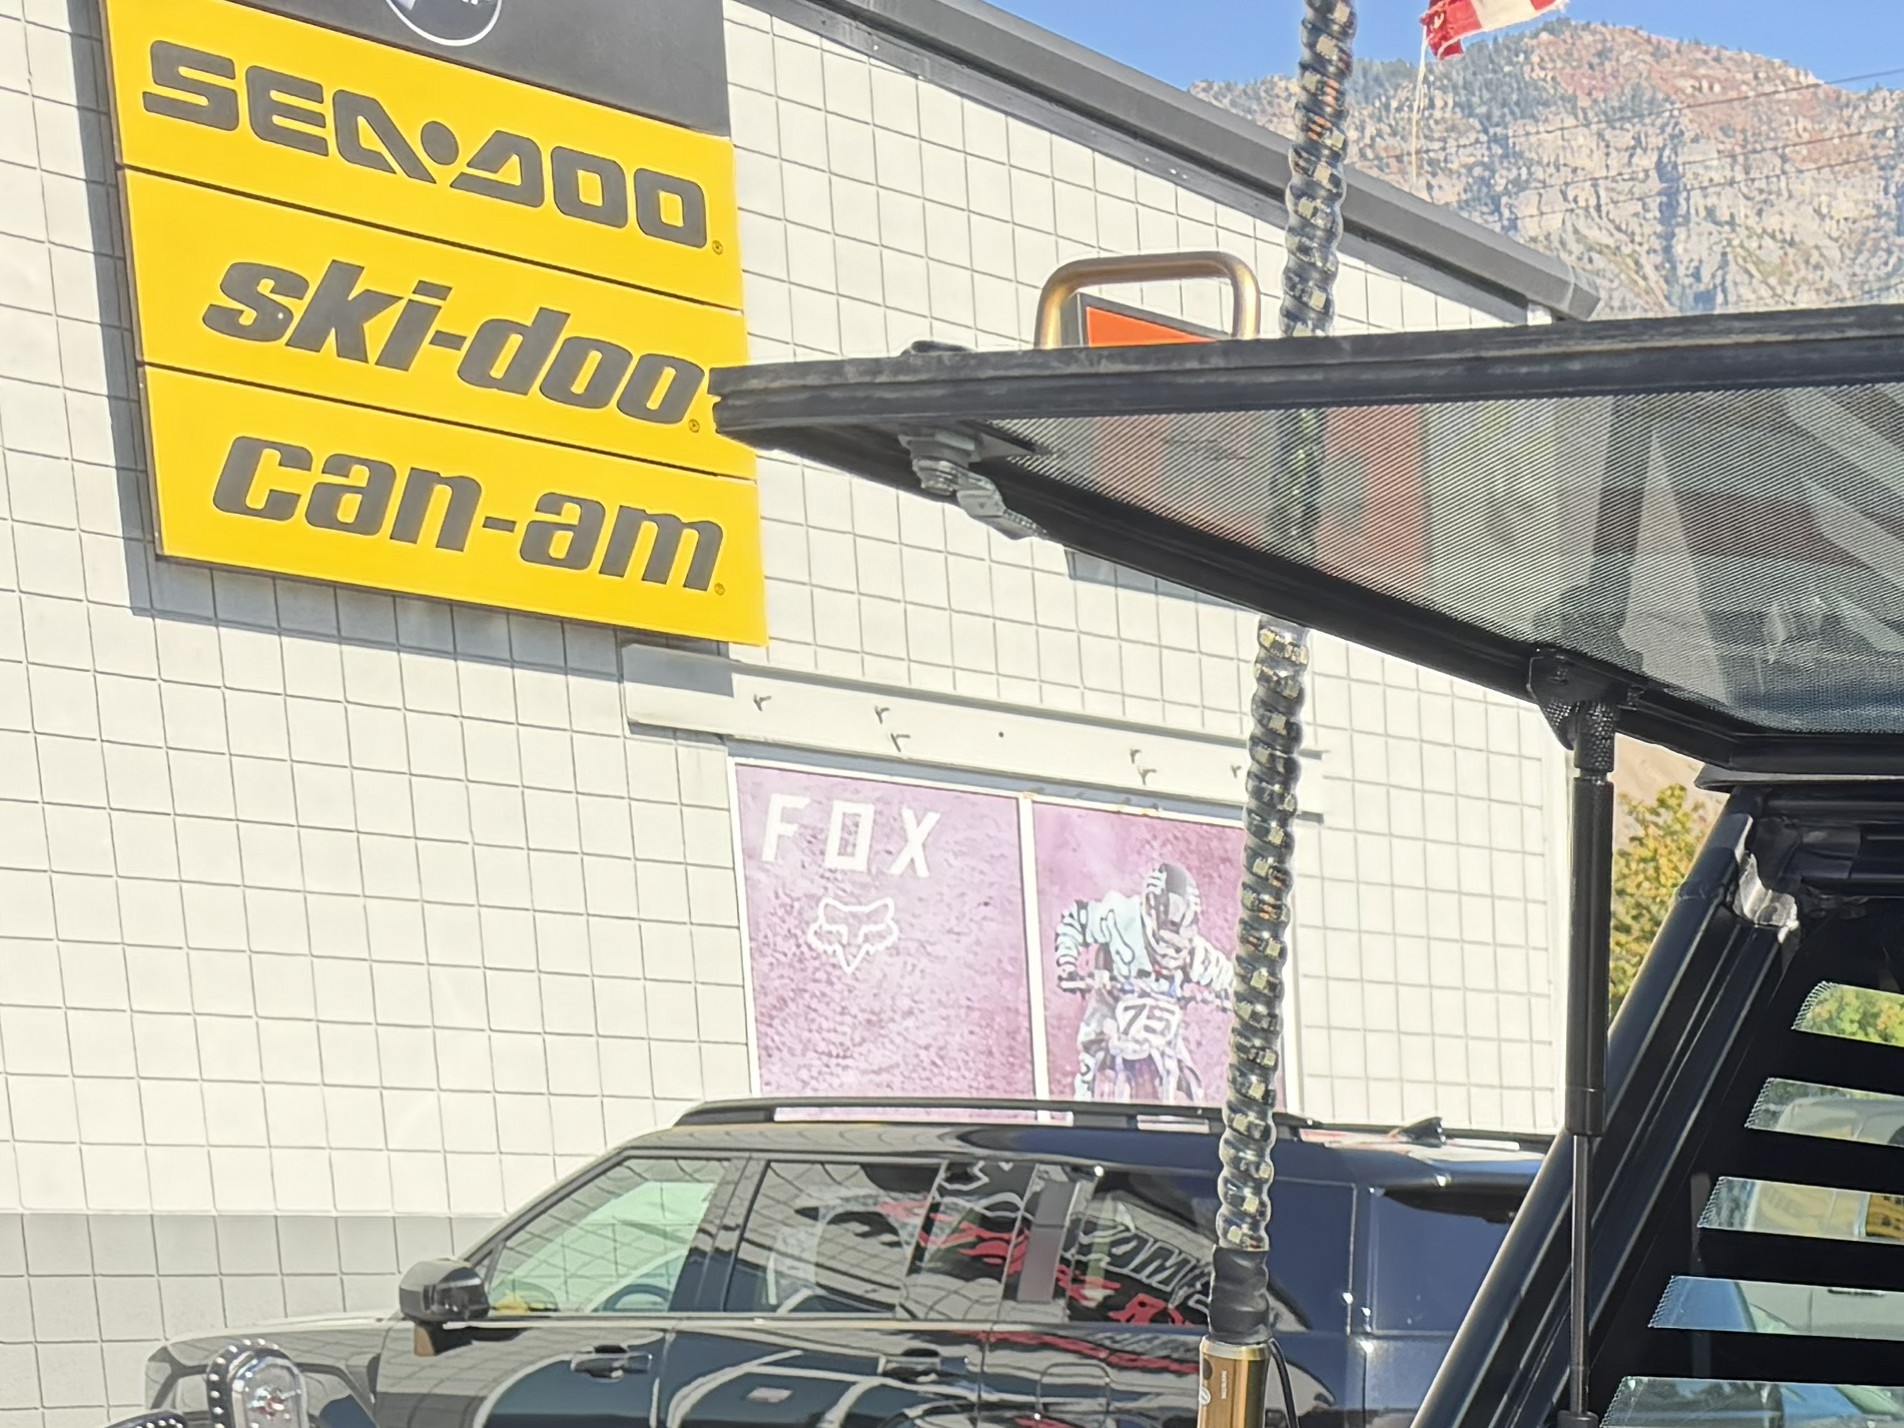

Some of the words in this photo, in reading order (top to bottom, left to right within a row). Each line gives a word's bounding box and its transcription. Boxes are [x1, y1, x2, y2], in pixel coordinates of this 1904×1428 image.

[201, 259, 706, 425] ski-doo
[212, 435, 724, 592] can-am
[761, 793, 941, 879] FOX
